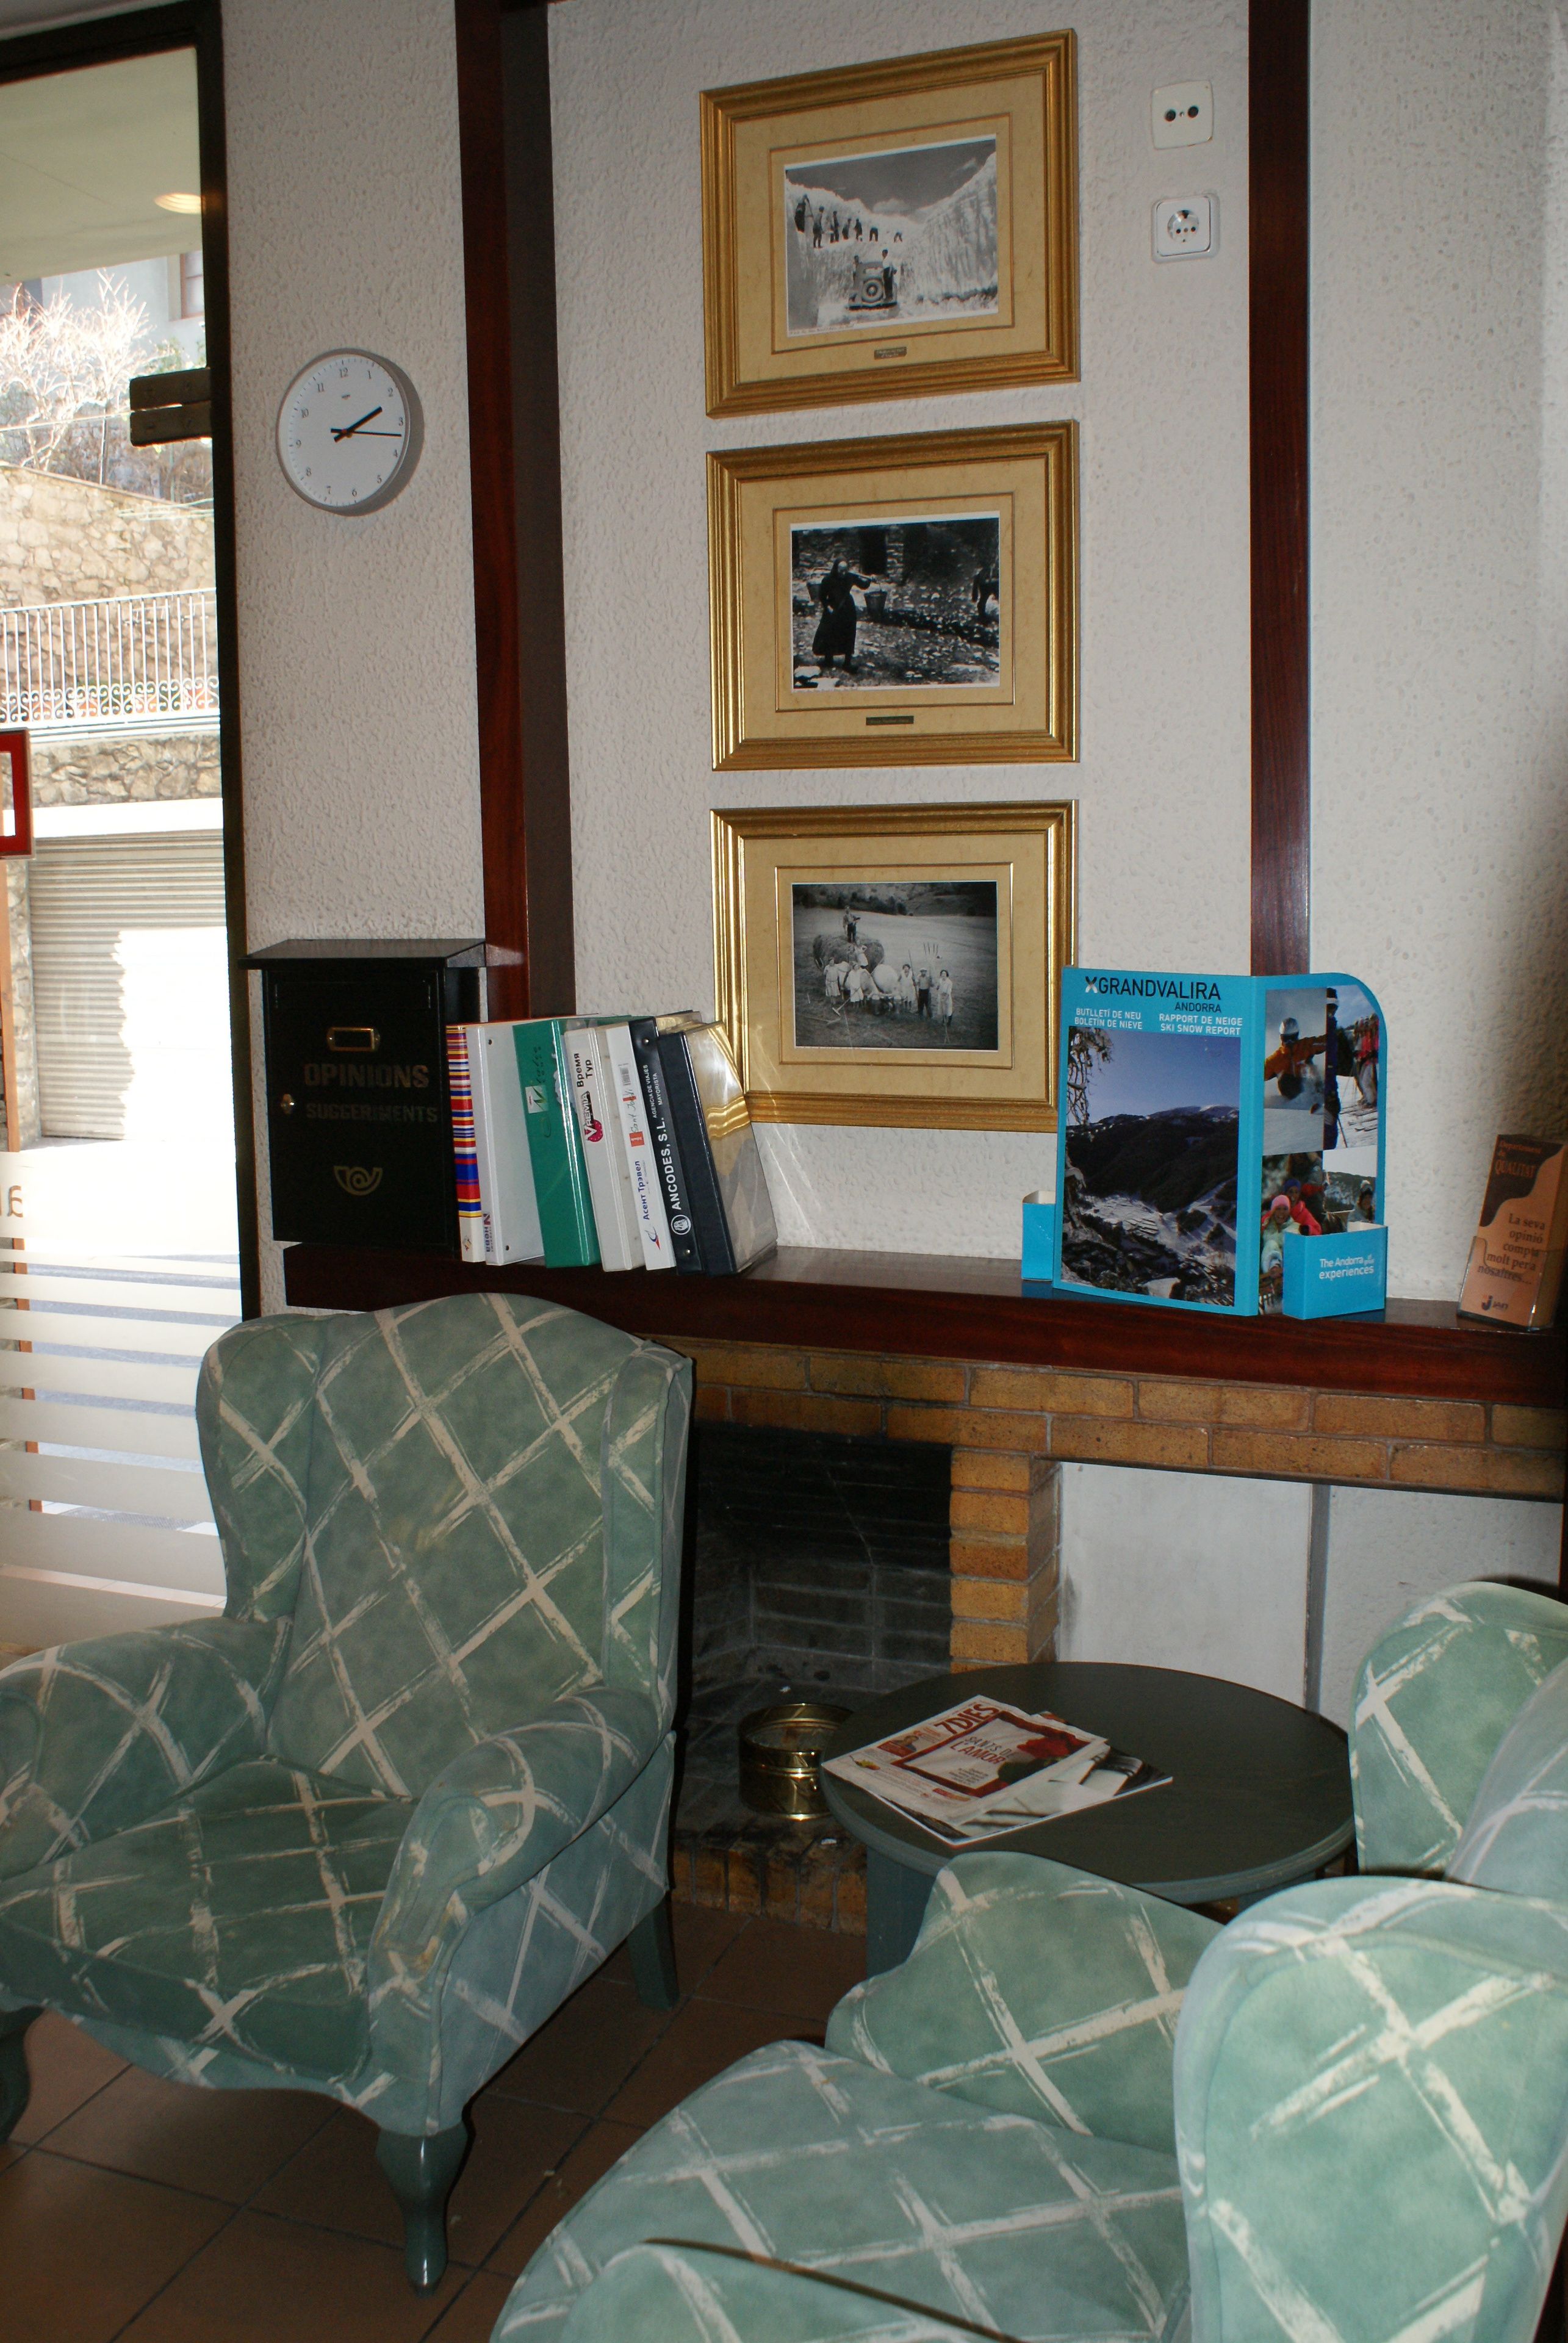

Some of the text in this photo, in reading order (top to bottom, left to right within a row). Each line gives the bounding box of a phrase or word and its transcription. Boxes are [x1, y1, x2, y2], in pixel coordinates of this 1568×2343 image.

[339, 367, 348, 378] 12
[367, 370, 372, 379] 1
[317, 383, 324, 392] 11
[387, 387, 394, 397] 2
[301, 408, 309, 418] 10
[398, 417, 403, 426] 3
[296, 439, 302, 448] 9
[394, 449, 398, 458] 4
[306, 468, 312, 477] 8
[377, 475, 383, 484] 5
[326, 486, 332, 494] 7
[352, 488, 358, 497] 6
[1099, 977, 1221, 1001] GRANDVALIRA
[1174, 1002, 1221, 1013] ANDORRA
[1112, 1010, 1123, 1018] DE
[1125, 1011, 1141, 1020] NEU
[1159, 1013, 1243, 1026] RAPPORT DE NEIGE
[1107, 1019, 1117, 1028] DE
[1120, 1020, 1143, 1030] NIEVE
[1160, 1023, 1241, 1035] SKI SNOW REPORT
[574, 1053, 584, 1087] Время
[585, 1059, 594, 1079] Тур
[304, 1064, 430, 1088] OPINIONS
[653, 1073, 663, 1105] MAYORISTA
[581, 1090, 598, 1141] VREMIA
[656, 1117, 682, 1211] ANCODES, S.L.
[635, 1161, 646, 1193] Трэвел
[641, 1193, 650, 1220] Асент
[1508, 1213, 1545, 1230] La seva
[1509, 1230, 1544, 1244] opinió
[1320, 1258, 1334, 1268] The
[1335, 1256, 1364, 1267] Andorra
[1486, 1253, 1510, 1264] molt
[1319, 1266, 1375, 1281] experiences
